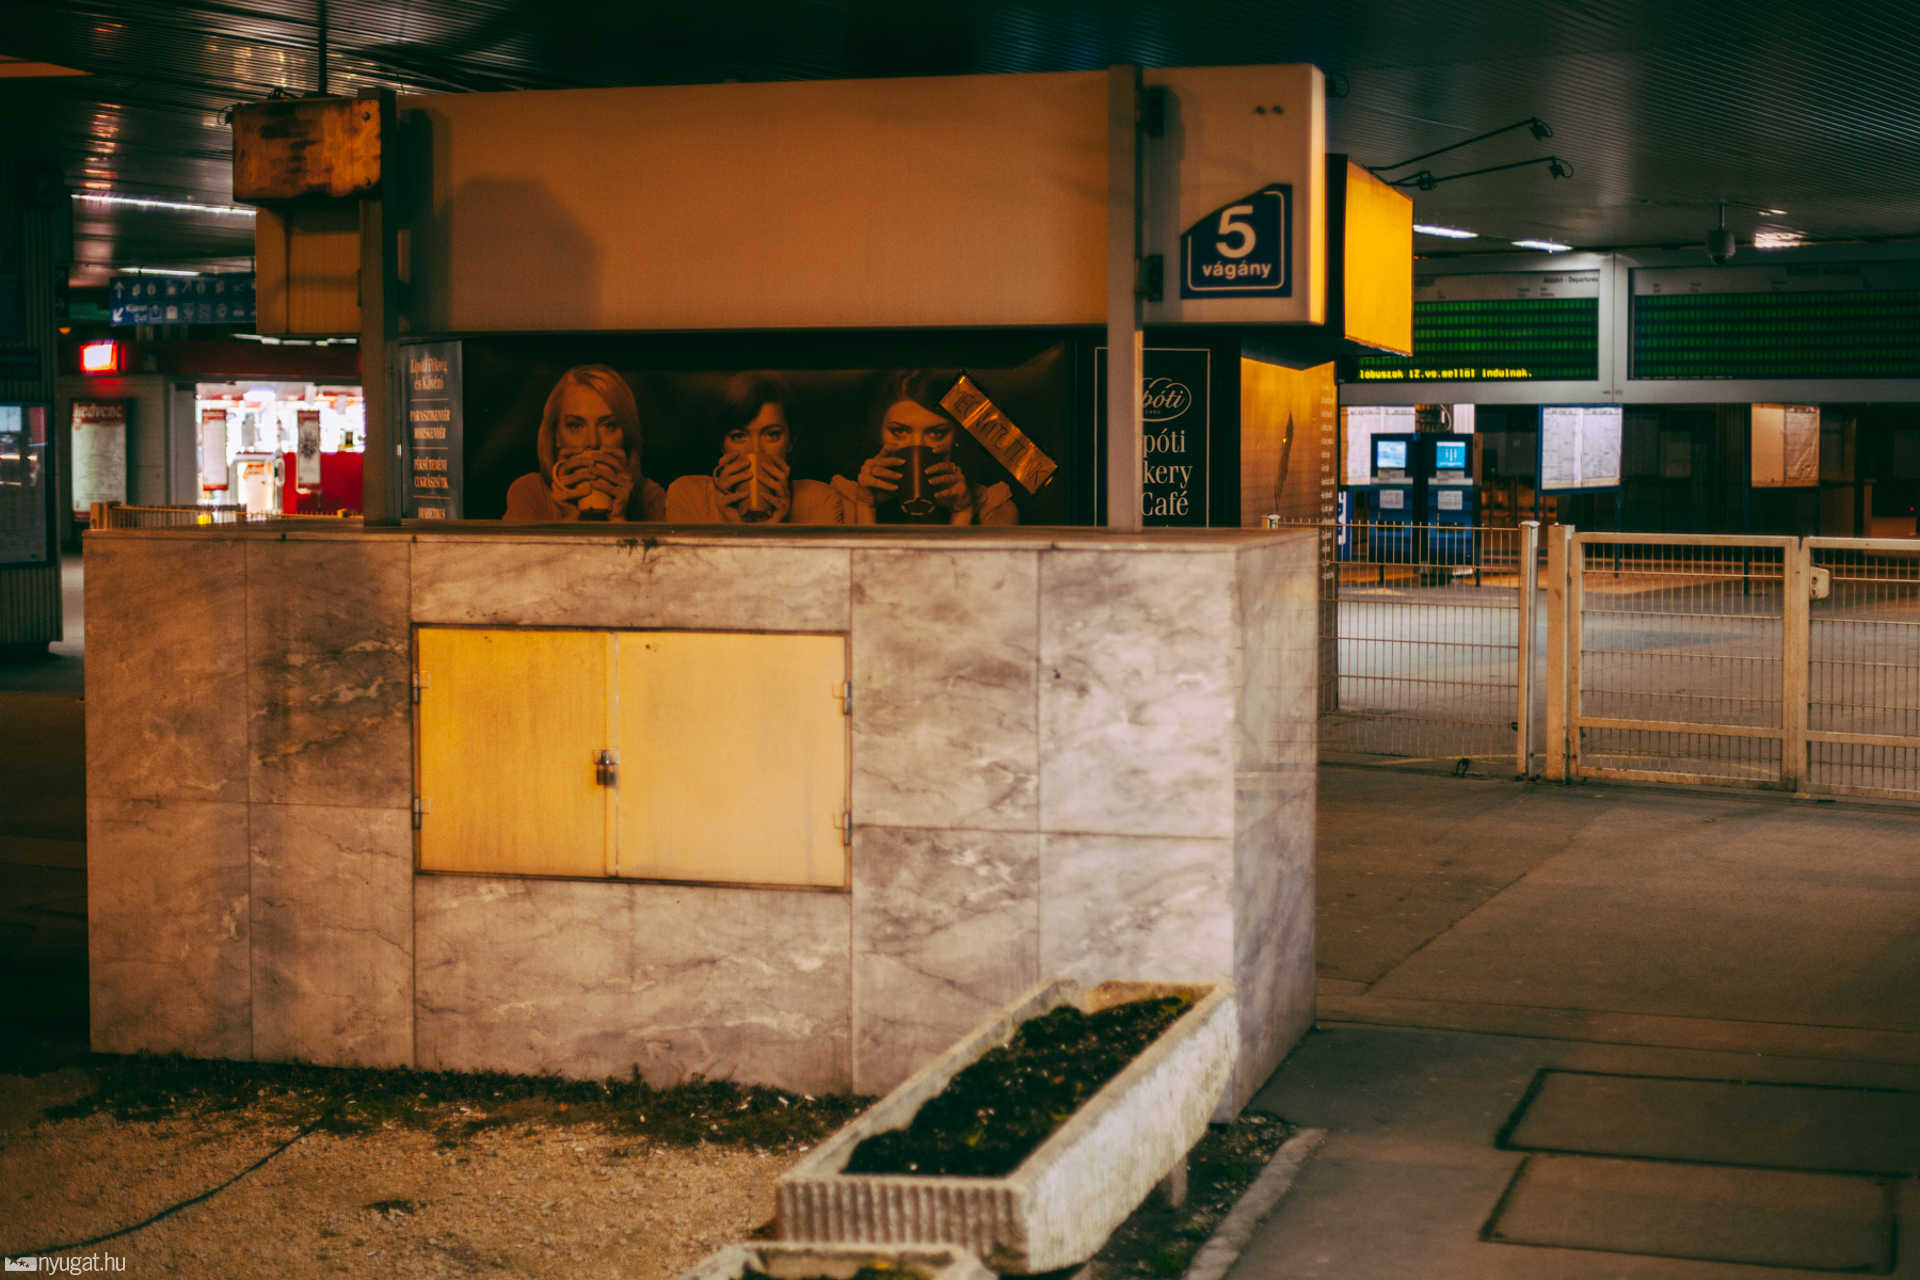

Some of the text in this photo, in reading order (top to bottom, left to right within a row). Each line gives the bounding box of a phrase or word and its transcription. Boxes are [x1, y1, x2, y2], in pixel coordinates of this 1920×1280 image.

[1215, 204, 1257, 259] 5
[1201, 260, 1273, 280] vágány
[1143, 390, 1186, 408] póti
[1143, 428, 1186, 458] póti
[1143, 460, 1193, 489] kery
[1141, 489, 1190, 517] Café
